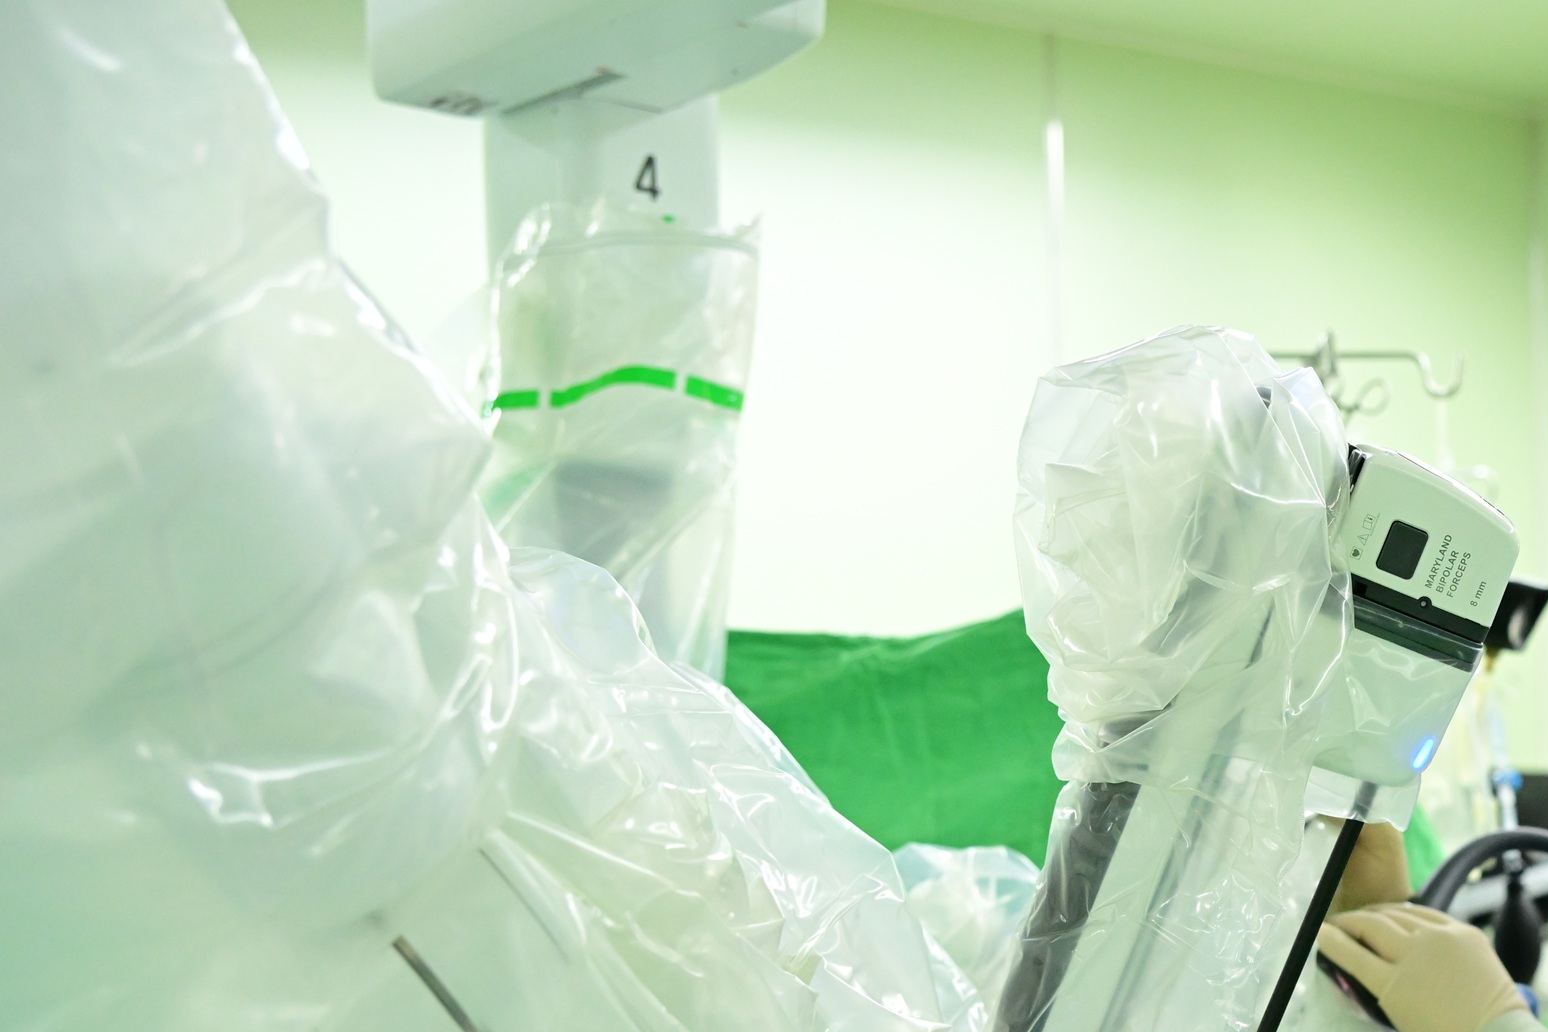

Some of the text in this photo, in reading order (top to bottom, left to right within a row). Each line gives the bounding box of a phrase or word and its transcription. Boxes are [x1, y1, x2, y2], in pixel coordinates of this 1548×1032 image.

[634, 154, 661, 201] 4
[1425, 534, 1452, 588] MARYLAND
[1436, 550, 1459, 593] BIPOLAR
[1446, 552, 1471, 598] FORCEPS
[1475, 581, 1487, 599] mm
